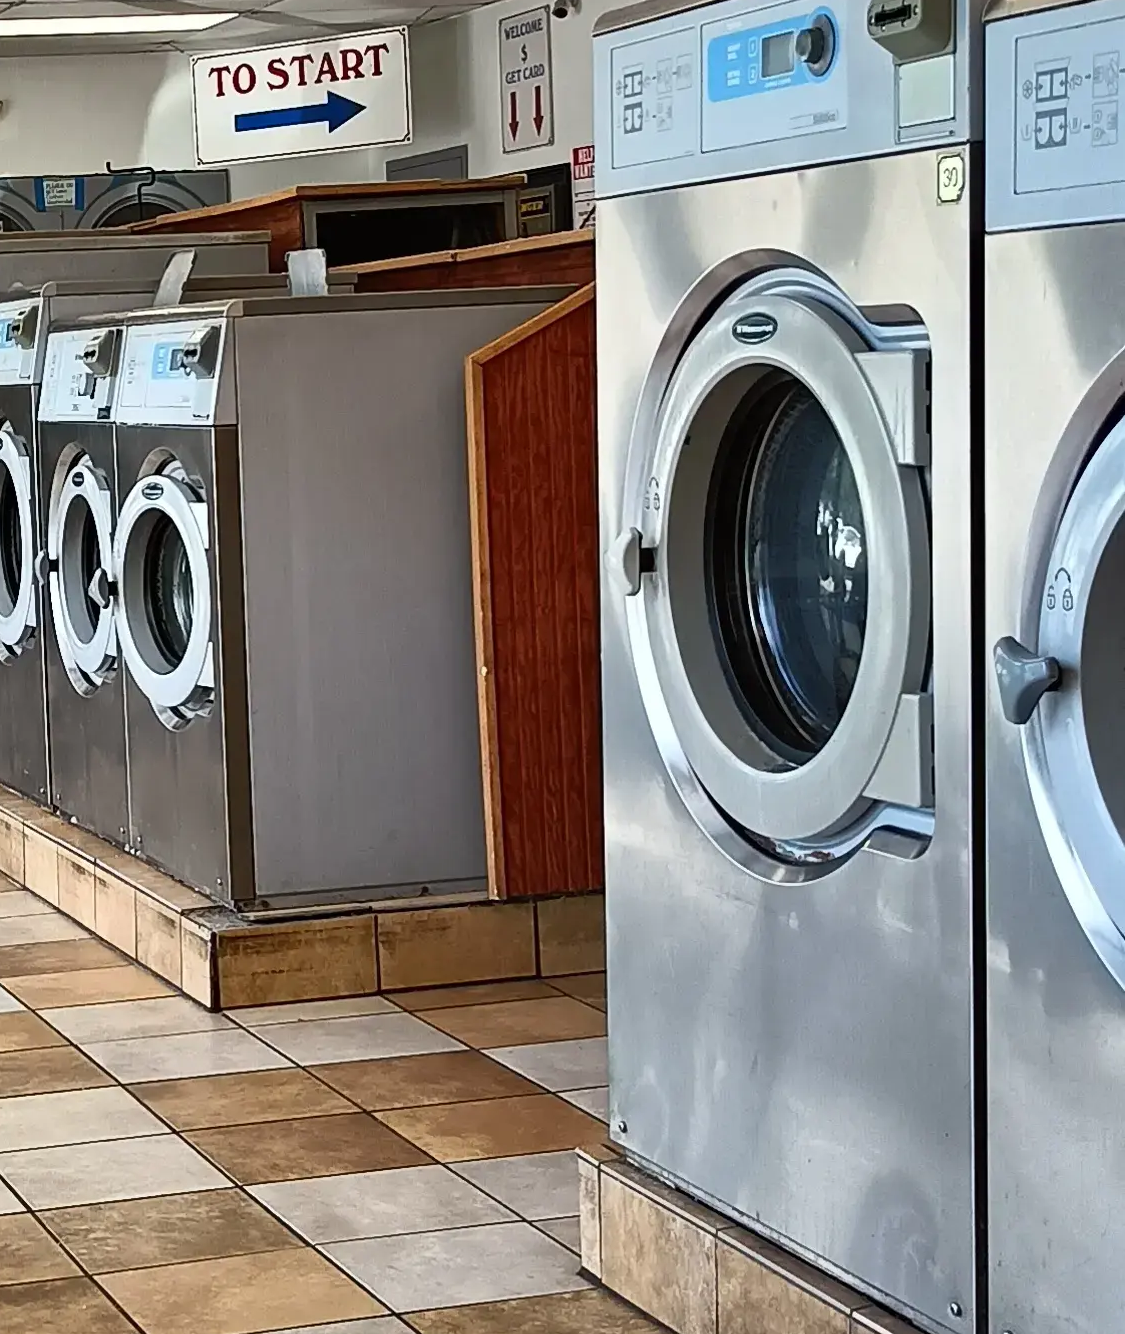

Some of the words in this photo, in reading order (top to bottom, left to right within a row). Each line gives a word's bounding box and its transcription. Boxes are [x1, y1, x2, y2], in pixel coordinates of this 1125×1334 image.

[504, 18, 544, 41] WELCOME
[520, 43, 528, 64] $
[208, 63, 257, 97] TO
[266, 43, 390, 91] START
[505, 69, 522, 84] GET
[523, 63, 545, 80] CARD
